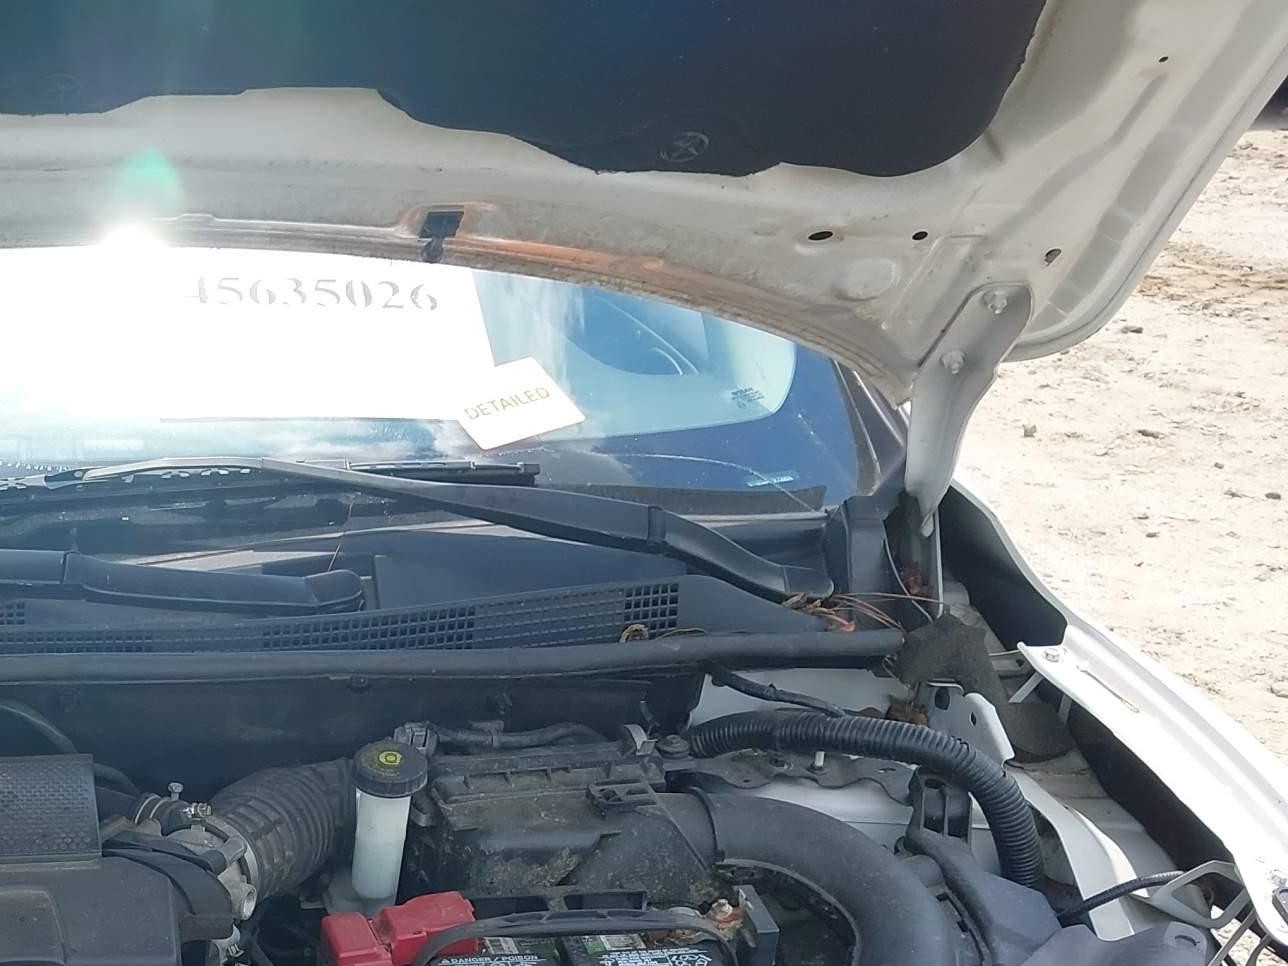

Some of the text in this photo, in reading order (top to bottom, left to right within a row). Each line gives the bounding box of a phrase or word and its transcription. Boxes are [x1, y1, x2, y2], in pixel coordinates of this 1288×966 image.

[463, 386, 550, 420] DETAILED
[450, 956, 492, 964] DANGER
[501, 954, 538, 962] POISON
